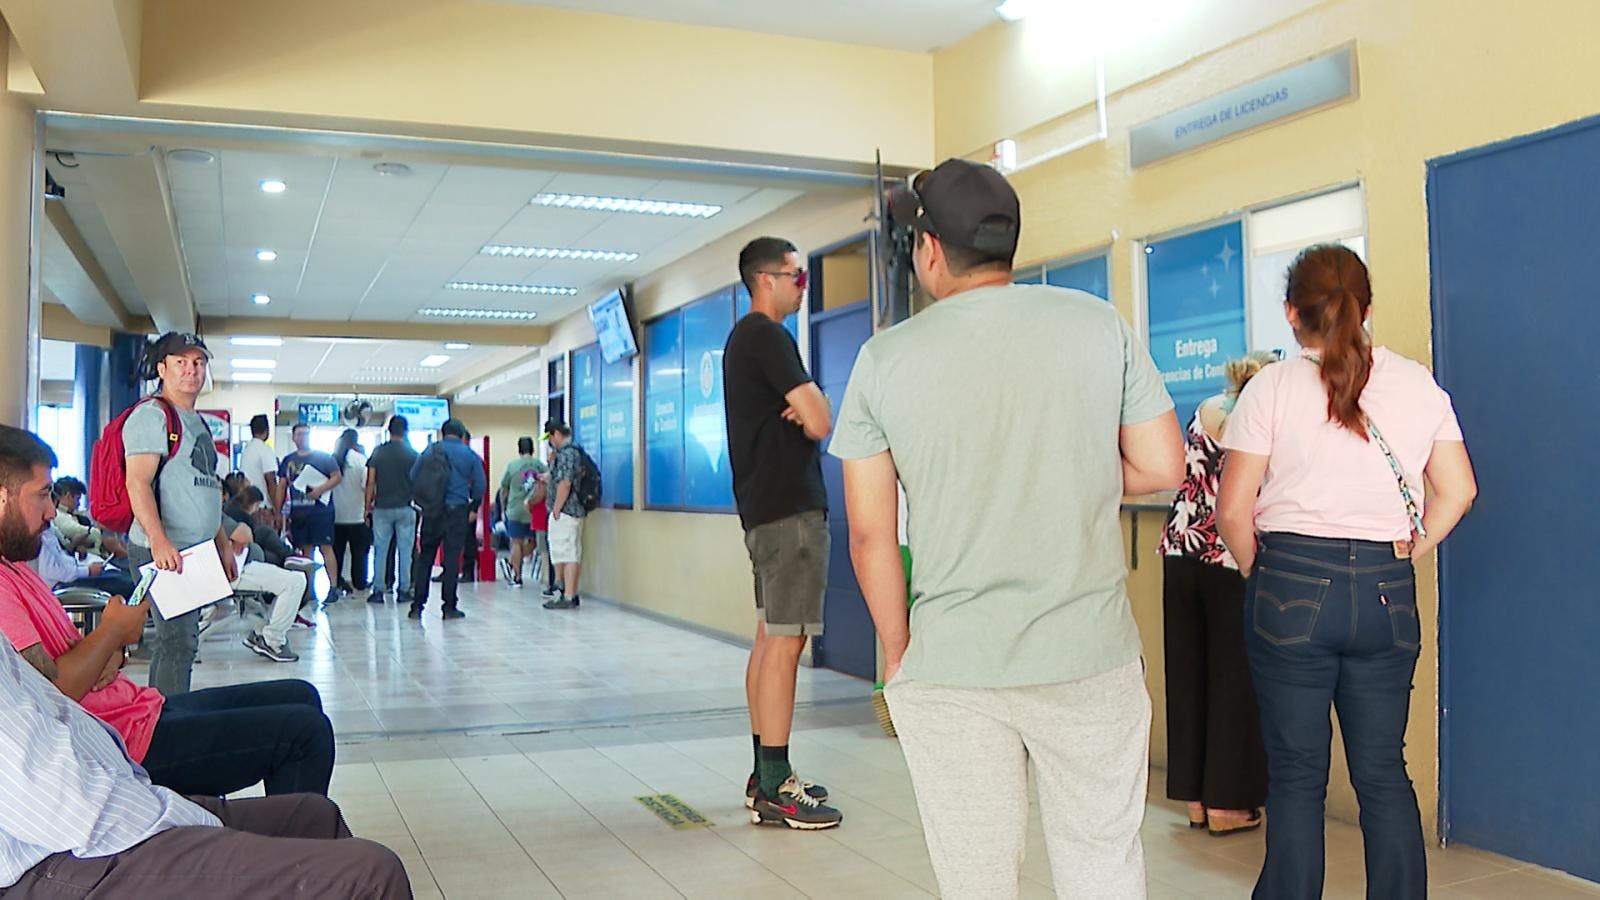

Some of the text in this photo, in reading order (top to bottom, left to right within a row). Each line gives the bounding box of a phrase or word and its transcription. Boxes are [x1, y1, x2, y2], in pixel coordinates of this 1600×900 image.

[1175, 88, 1289, 138] ENTREGA DE LICENCIAS
[1175, 338, 1218, 359] Entrega
[1193, 365, 1204, 380] de
